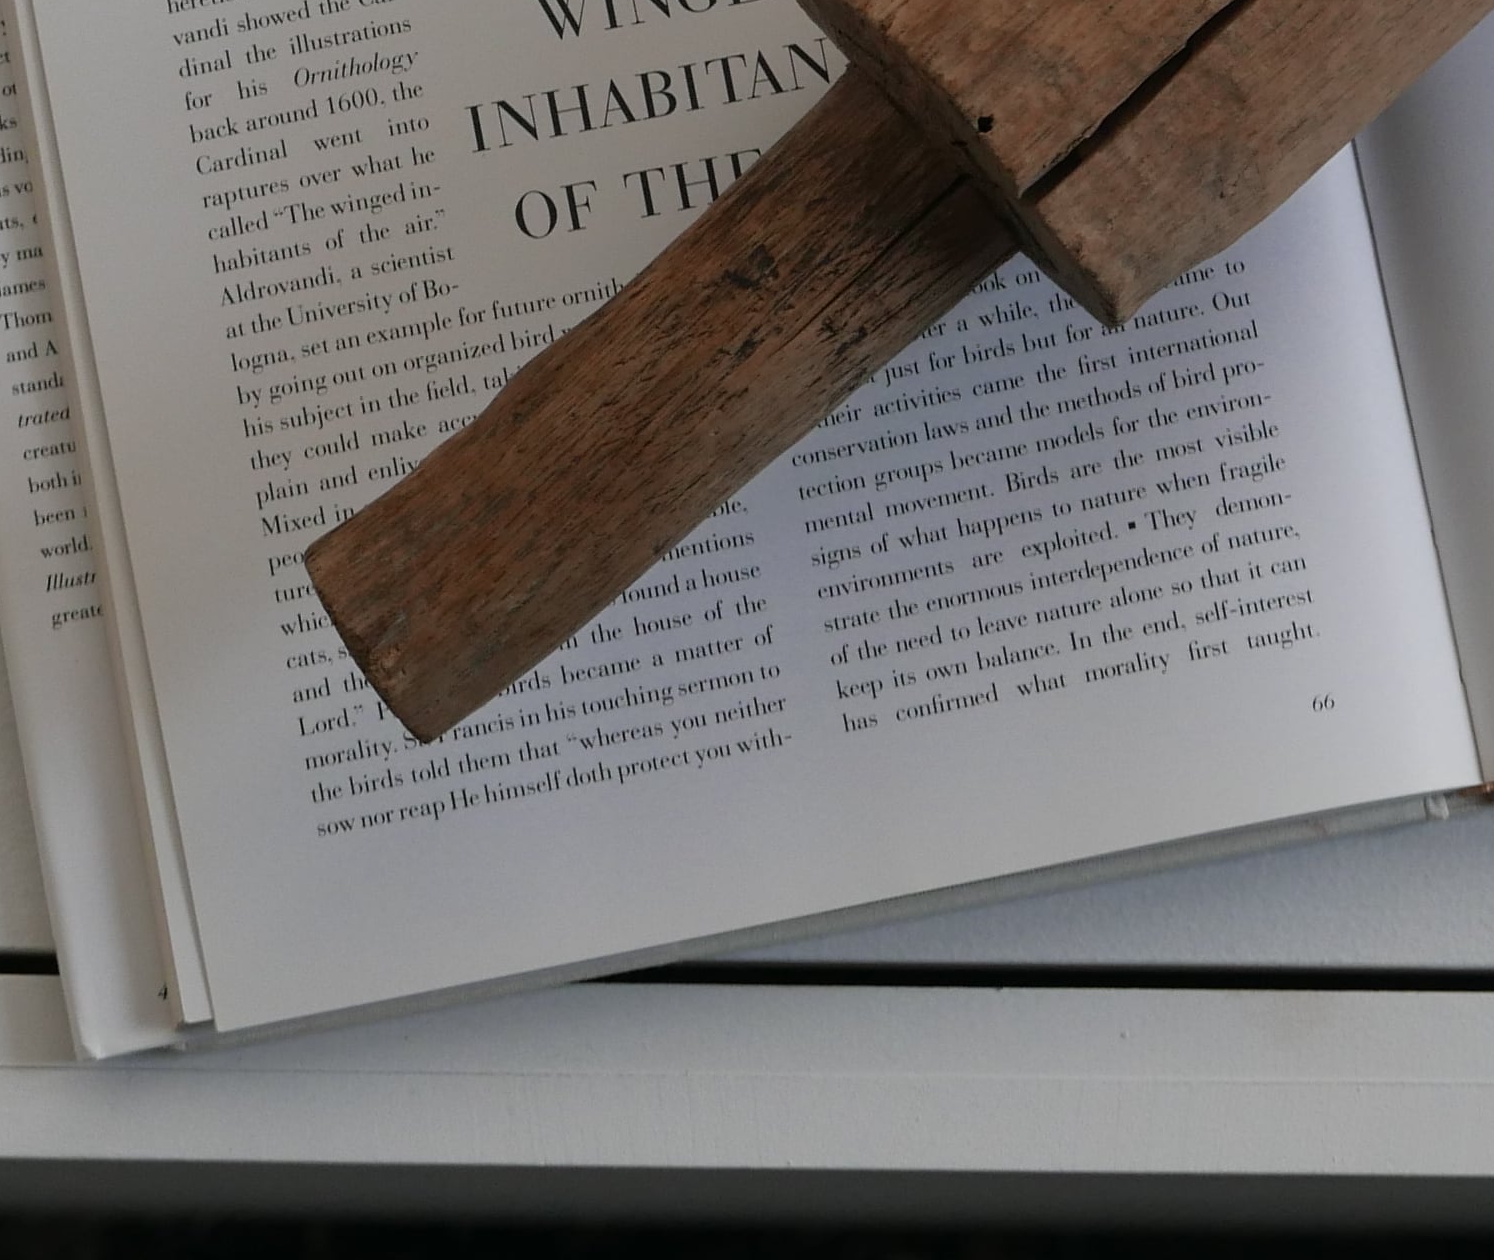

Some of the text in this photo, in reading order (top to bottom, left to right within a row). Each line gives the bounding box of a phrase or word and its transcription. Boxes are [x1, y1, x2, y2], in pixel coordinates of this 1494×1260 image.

[178, 19, 412, 78] dinal the illustrations
[185, 51, 419, 111] for his Ornithology
[189, 80, 423, 144] back around 1600, the
[463, 37, 831, 153] INHABITAN
[514, 179, 597, 240] OF
[6, 341, 39, 364] and
[836, 589, 1313, 700] keep its own balance. In the end, self-interest
[842, 620, 1320, 733] has confirmed what morality first taught.
[1312, 694, 1335, 712] 66
[311, 781, 343, 804] the
[348, 767, 404, 796] birds
[411, 756, 451, 784] told
[458, 752, 511, 775] them
[518, 740, 559, 763] that
[670, 714, 707, 740] you
[714, 696, 787, 725] neither
[317, 727, 792, 837] sow nor reap He himself doth protect you with-
